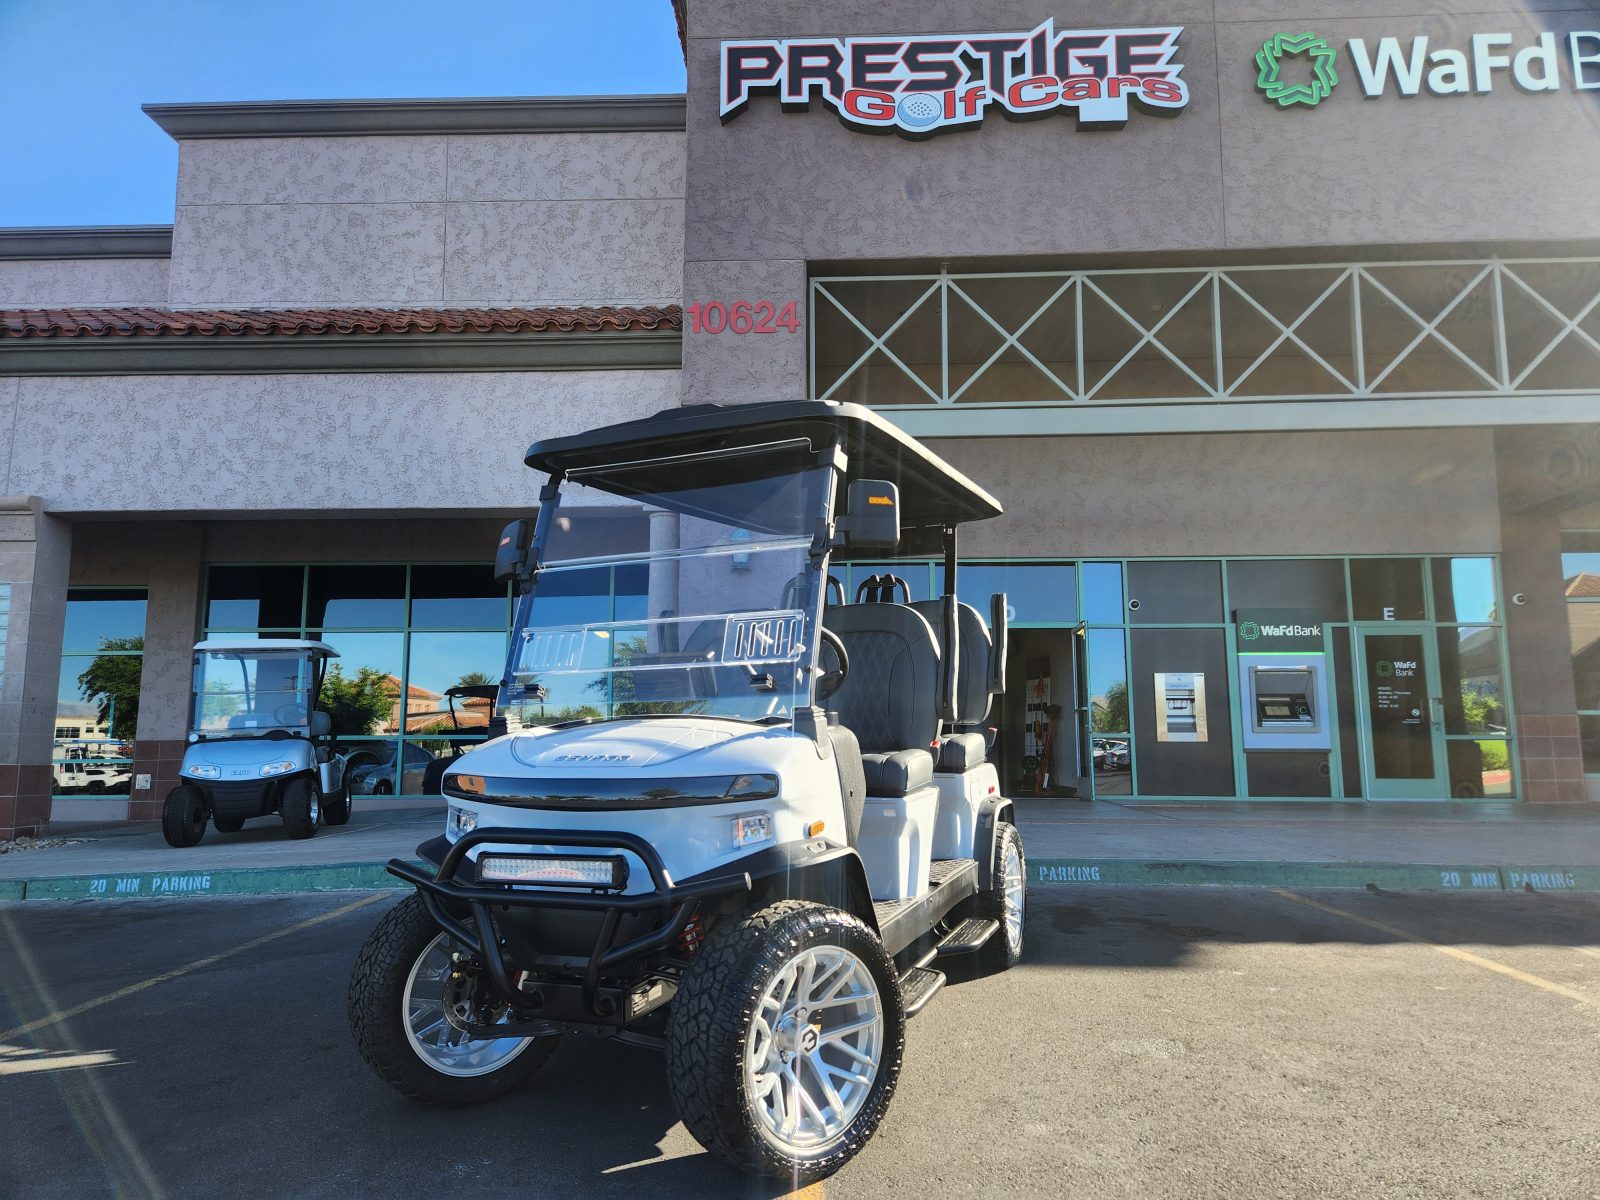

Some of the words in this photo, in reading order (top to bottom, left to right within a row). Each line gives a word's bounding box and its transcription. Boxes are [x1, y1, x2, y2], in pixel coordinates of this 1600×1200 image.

[724, 26, 1175, 107] PRESTIGE
[1348, 31, 1560, 97] WaFd
[844, 85, 987, 127] Golf
[1008, 76, 1183, 108] Cars
[686, 300, 800, 335] 10624
[1383, 607, 1395, 621] E
[1394, 661, 1417, 669] WaFd
[1395, 668, 1415, 677] Bank
[1039, 866, 1100, 881] PARKING
[1441, 871, 1461, 887] 20
[1471, 871, 1498, 888] MIN
[1510, 872, 1576, 888] PARKING
[90, 879, 107, 893] 20
[116, 878, 140, 893] MIN
[151, 875, 211, 892] PARKING
